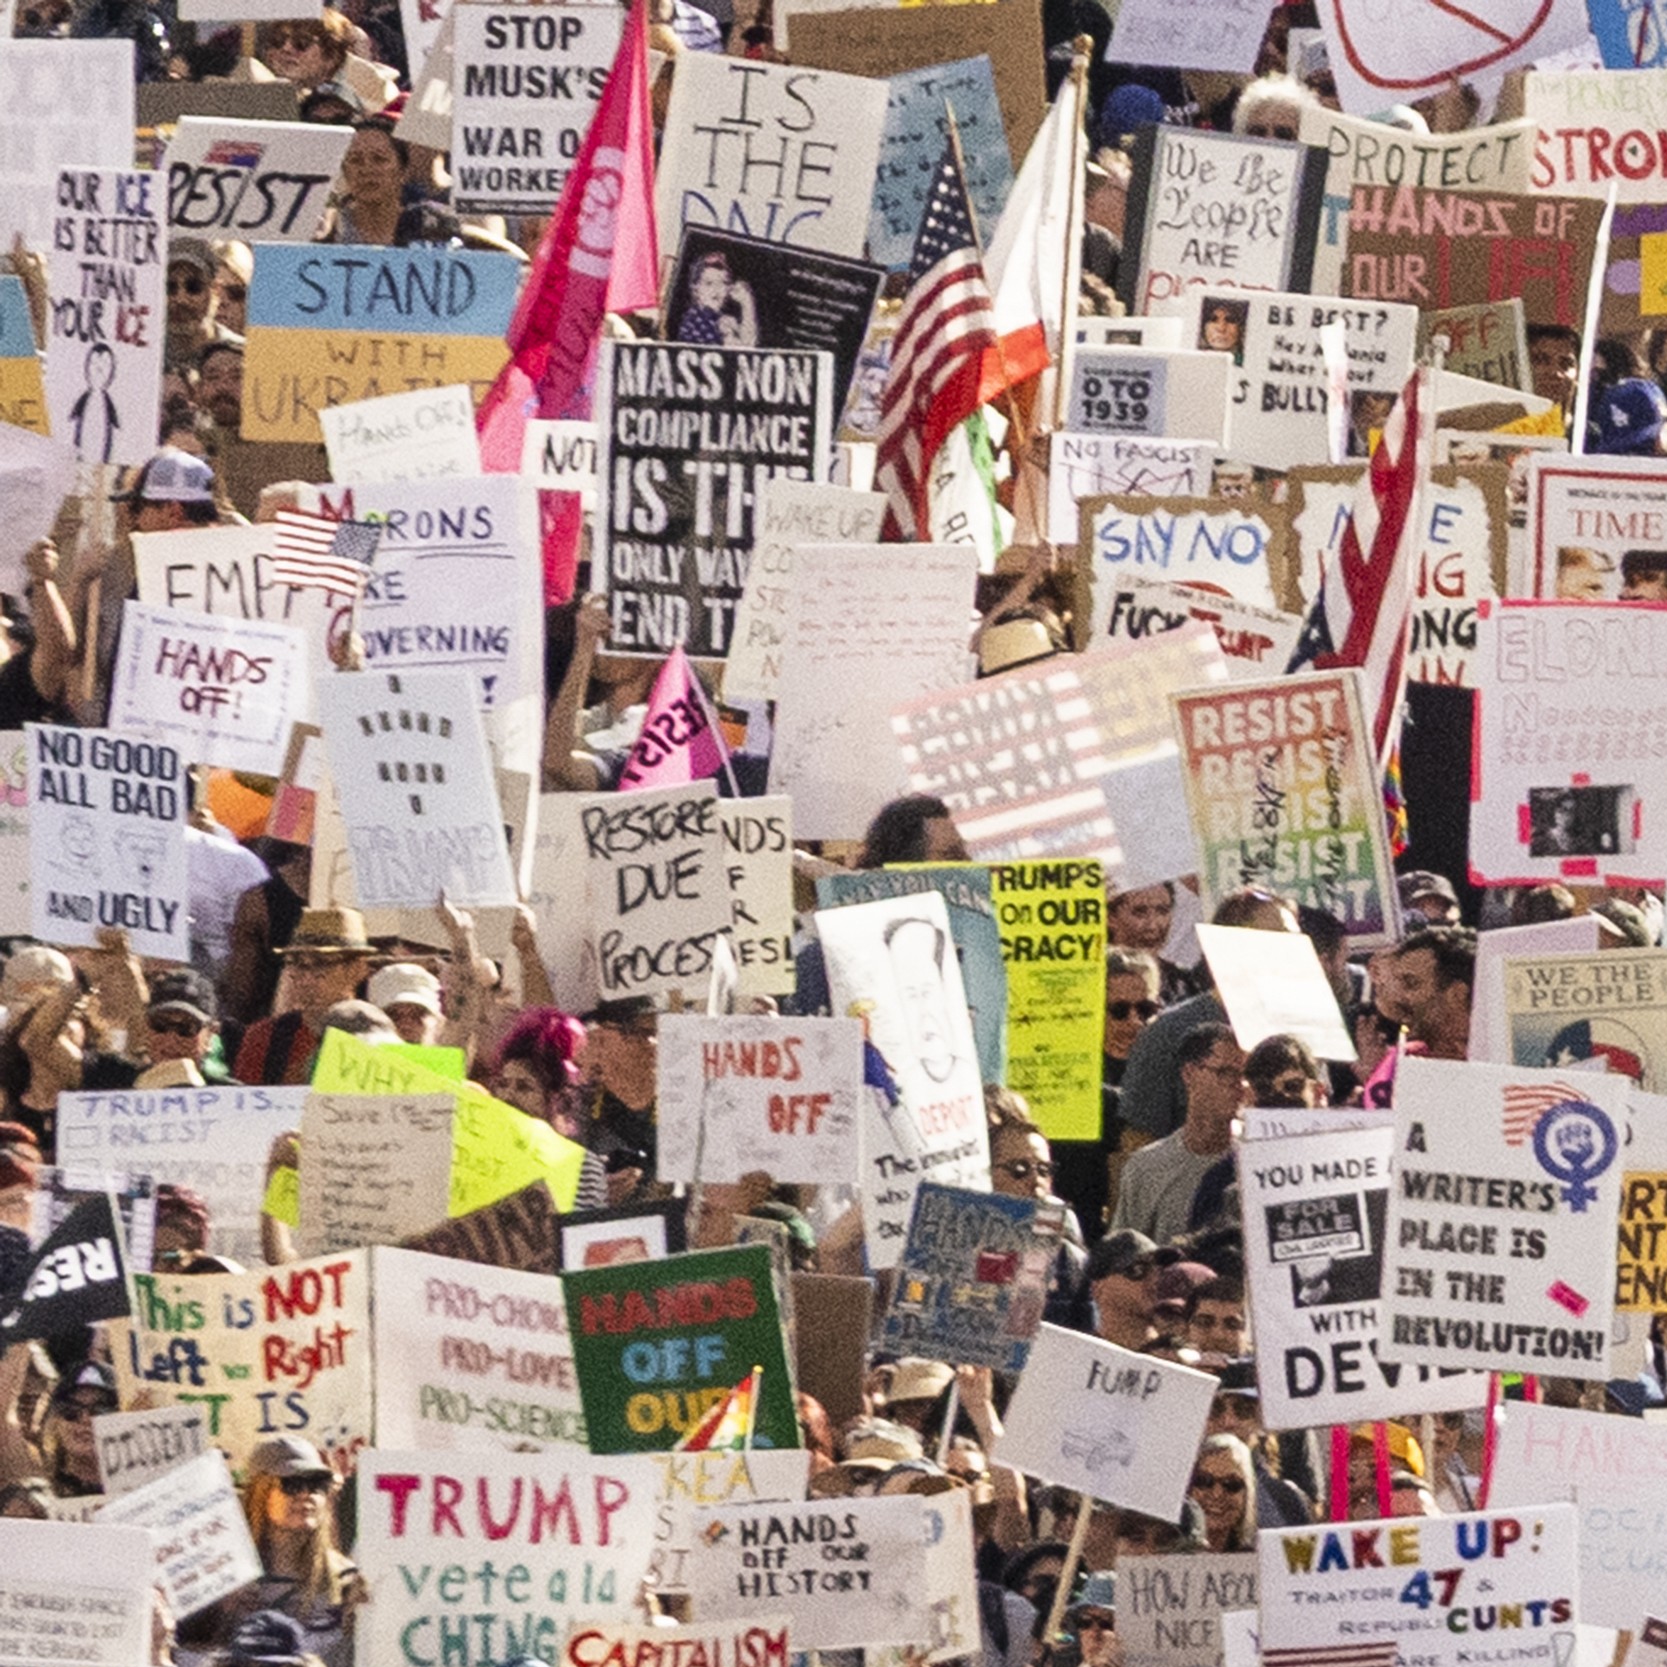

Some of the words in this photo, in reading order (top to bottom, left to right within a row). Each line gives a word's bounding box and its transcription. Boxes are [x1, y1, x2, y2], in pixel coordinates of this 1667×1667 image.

[485, 17, 581, 50] STOP
[1328, 129, 1517, 186] PROTECT
[58, 176, 104, 204] OUR
[116, 174, 151, 216] ICE
[55, 216, 76, 250] IS
[82, 222, 158, 261] BETTER
[80, 264, 135, 299] THAN
[297, 260, 475, 315] STAND
[52, 300, 105, 339] YOUR
[114, 305, 147, 345] ICE
[330, 340, 445, 365] WITH
[618, 352, 724, 398] MASS
[737, 355, 813, 400] NON
[618, 408, 809, 453] COMPLIANCE
[1101, 518, 1175, 564] SAY
[1189, 521, 1263, 563] NO
[1570, 510, 1661, 539] TIME
[1192, 692, 1338, 746] RESIST
[39, 733, 83, 766] NO
[90, 741, 179, 785] GOOD
[39, 770, 94, 803] ALL
[110, 780, 179, 819] BAD
[584, 803, 720, 858] RESTORE
[618, 854, 703, 912] DUE
[46, 894, 92, 922] AND
[100, 892, 179, 934] UGLY
[703, 1038, 805, 1080] HANDS
[767, 1095, 830, 1133] OFF
[1401, 1175, 1554, 1211] WRITER'S
[136, 1277, 205, 1332] This
[224, 1294, 254, 1328] is
[262, 1263, 352, 1320] NOT
[581, 1279, 757, 1331] HANDS
[623, 1336, 726, 1383] OFF
[376, 1474, 629, 1547] TRUMP
[1282, 1526, 1420, 1574] WAKE
[1448, 1599, 1570, 1633] CUNTS
